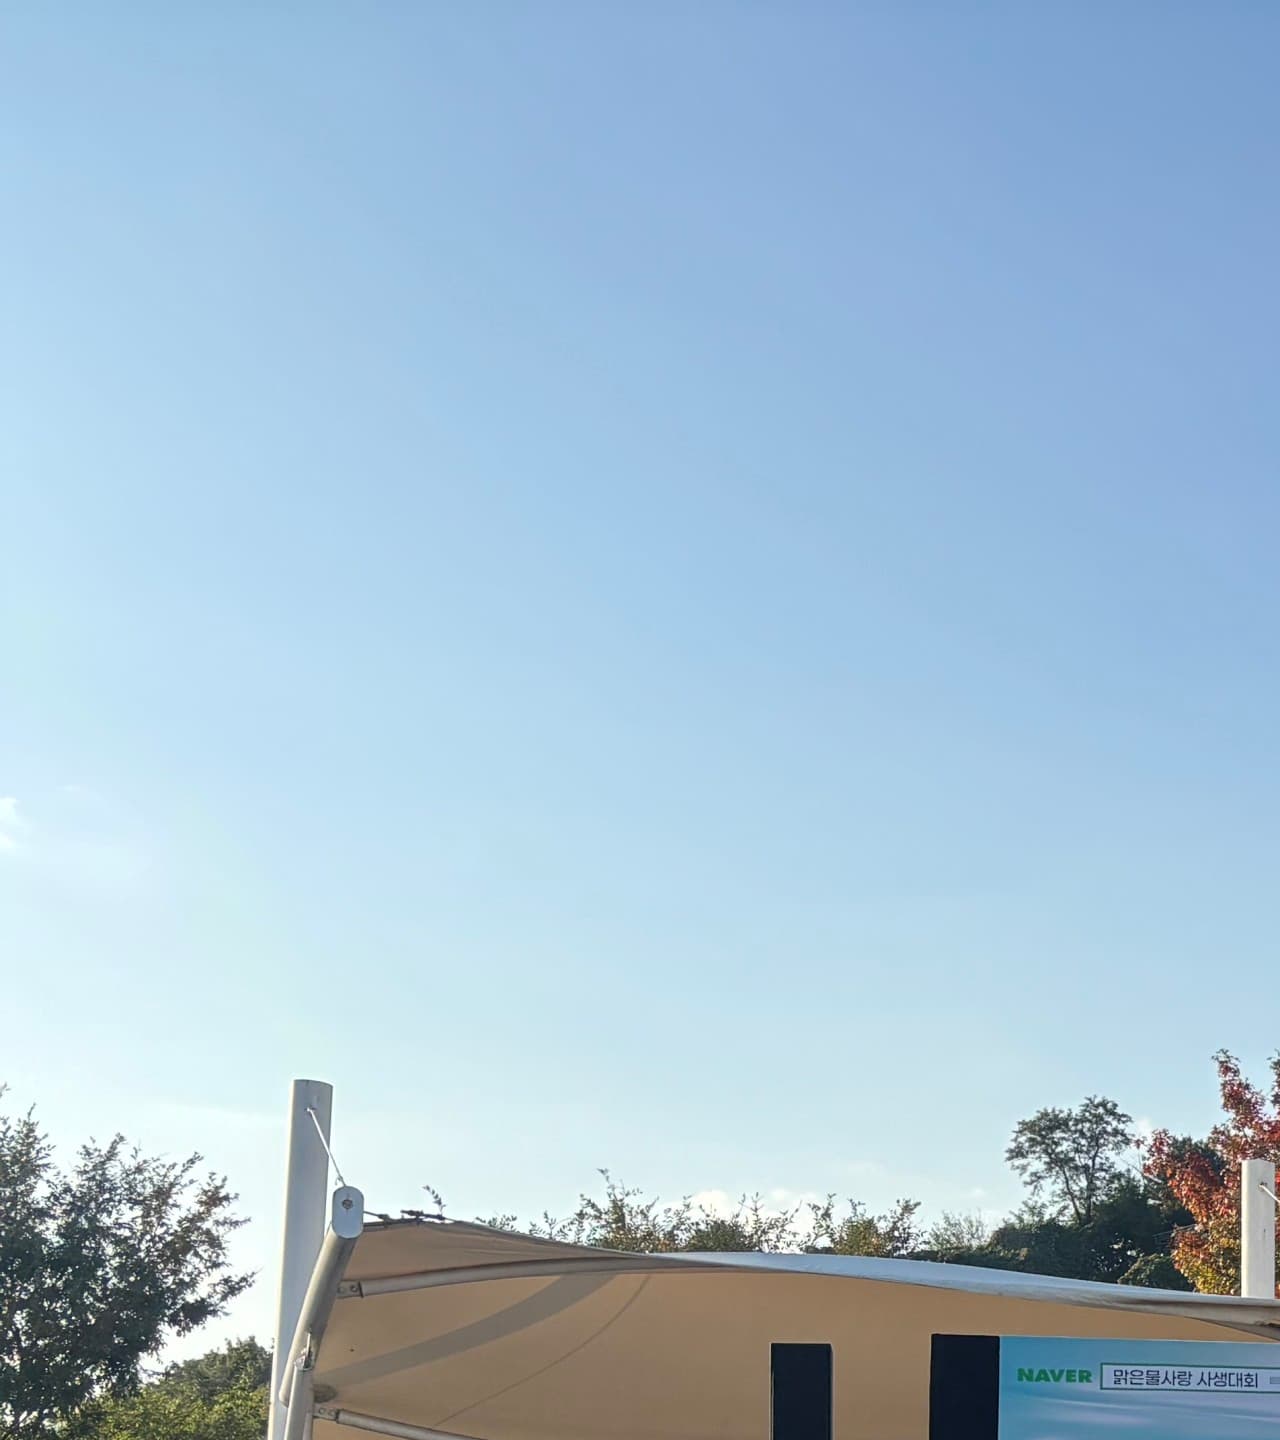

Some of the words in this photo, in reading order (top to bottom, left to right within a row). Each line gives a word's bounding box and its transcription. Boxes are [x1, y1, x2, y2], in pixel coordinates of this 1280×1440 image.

[1017, 1367, 1092, 1384] NAVER
[1113, 1368, 1193, 1387] 맑은물사랑
[1196, 1371, 1259, 1389] 사생대회
